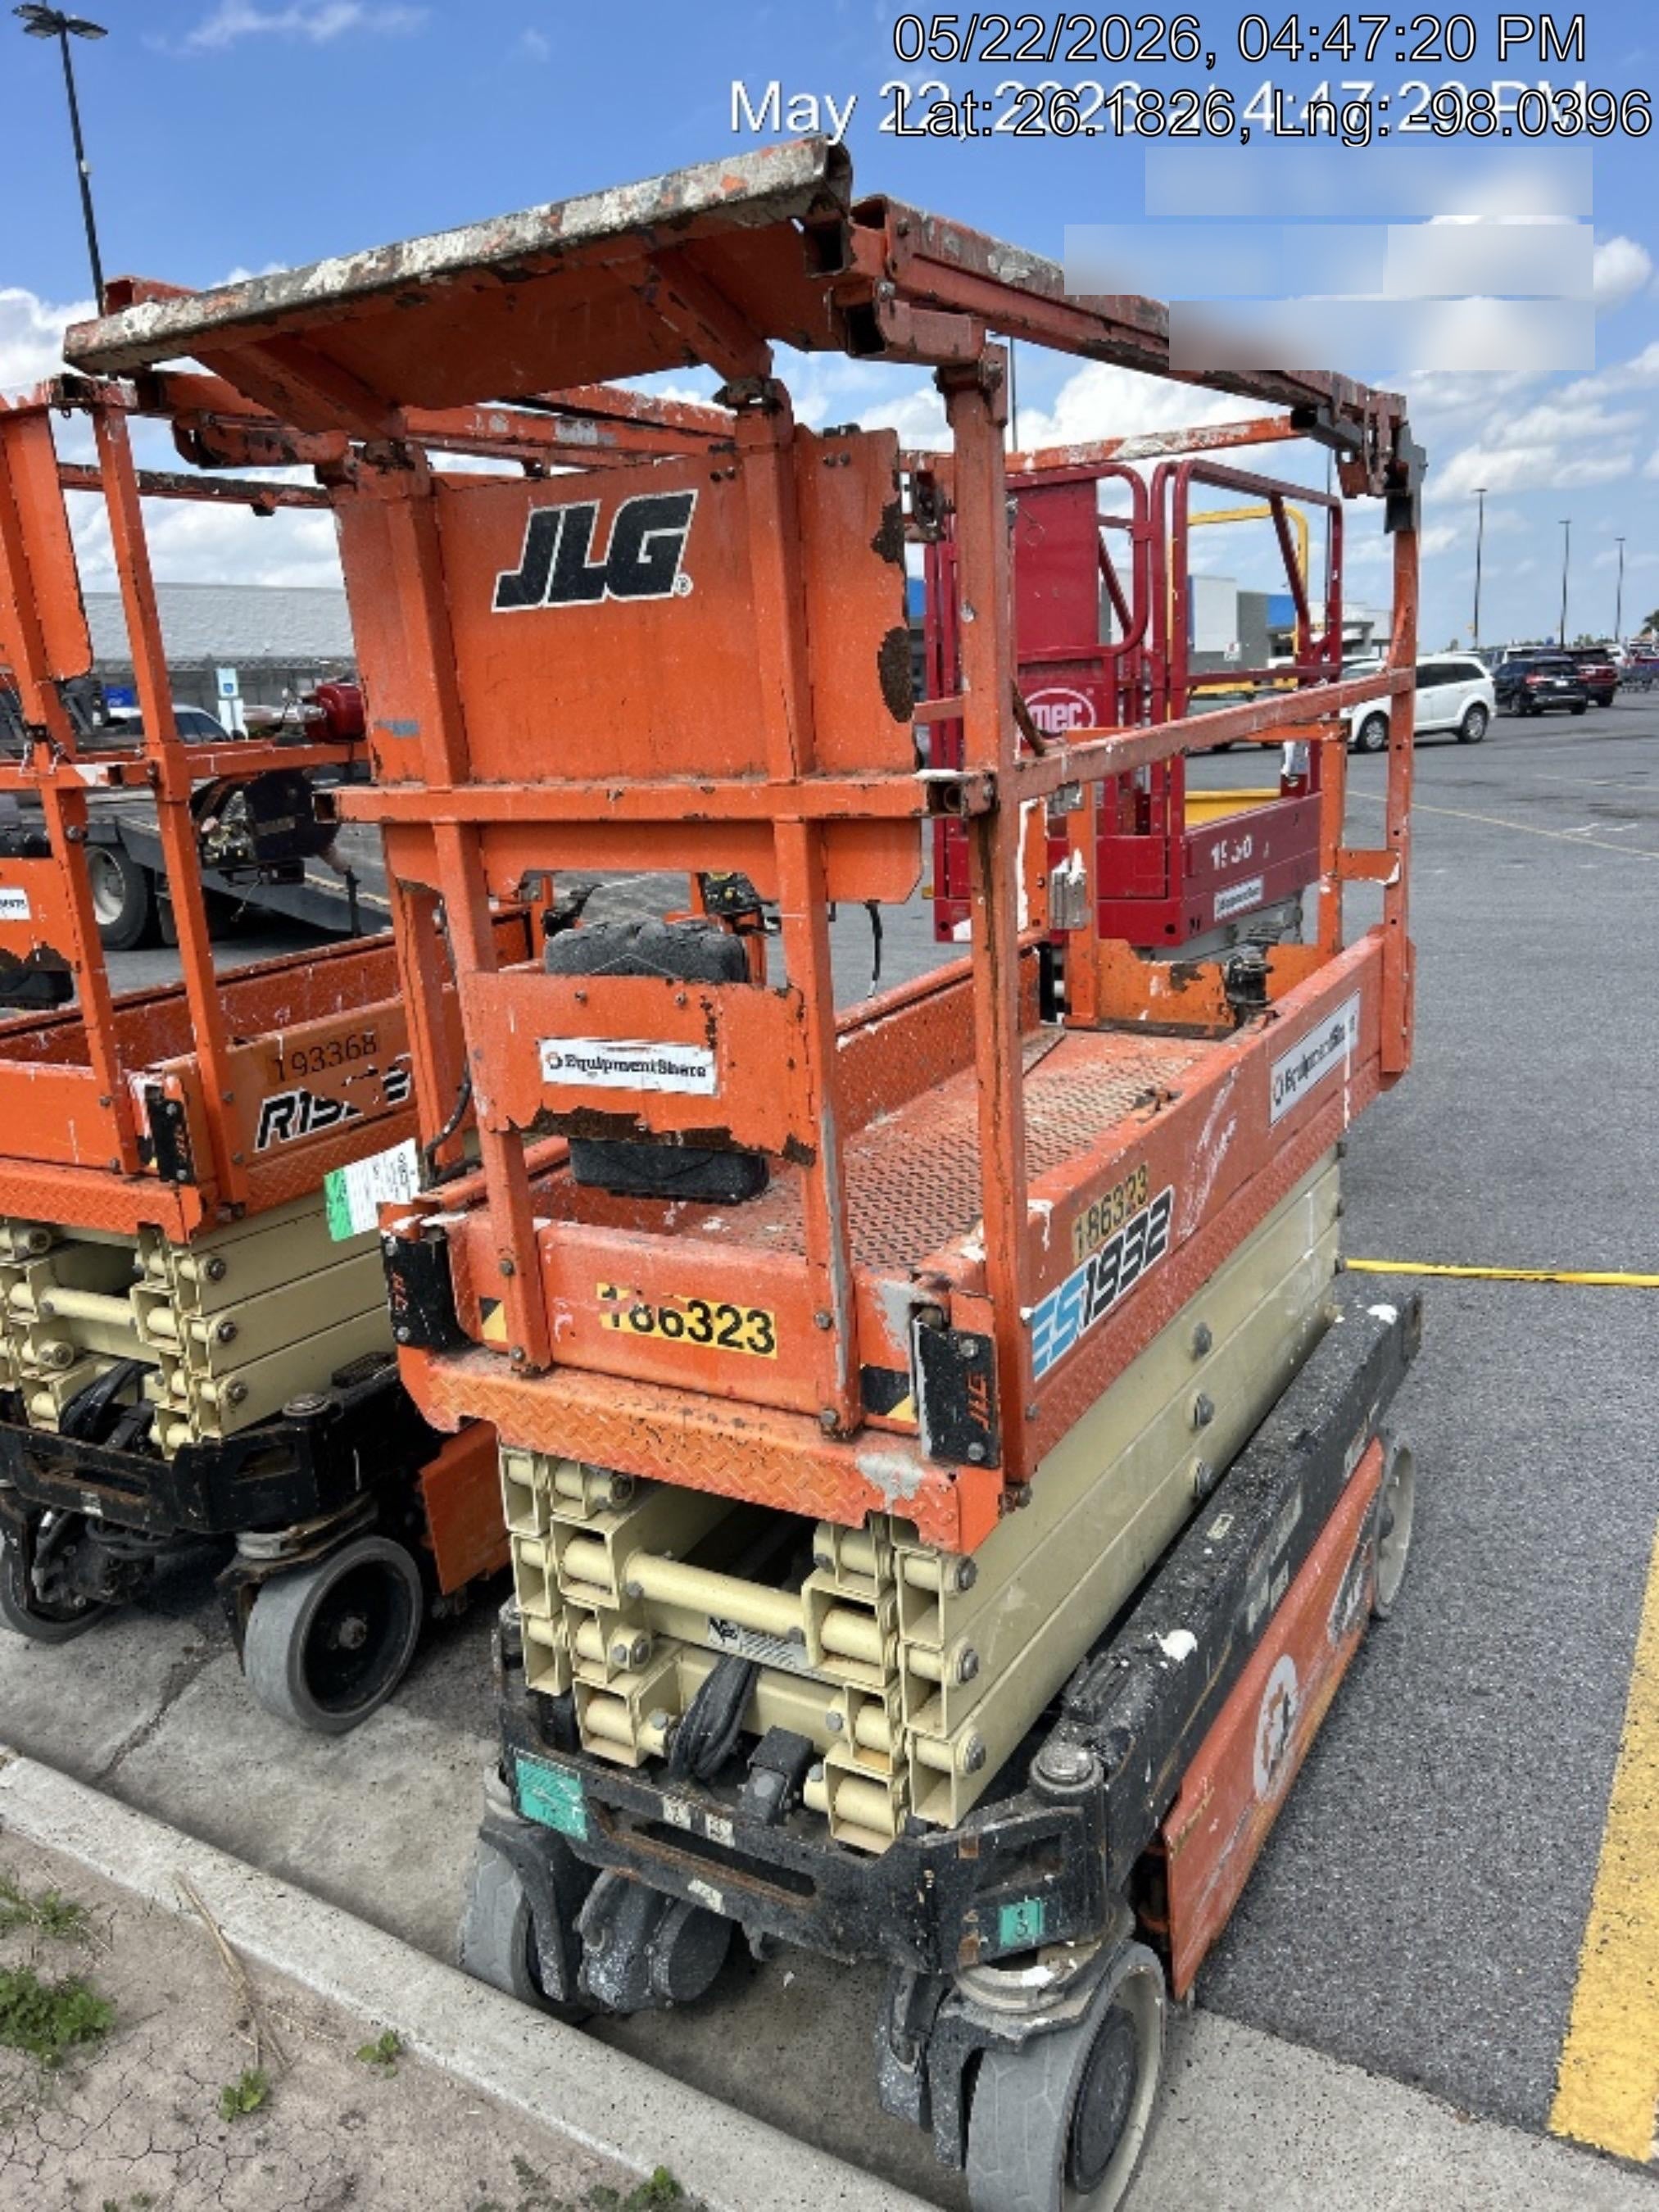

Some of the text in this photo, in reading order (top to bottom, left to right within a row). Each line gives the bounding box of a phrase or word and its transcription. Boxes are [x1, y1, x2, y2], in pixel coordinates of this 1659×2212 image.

[492, 489, 698, 613] JLG
[273, 1031, 377, 1081] 193368
[564, 1054, 706, 1077] EquipmentShare
[1031, 1185, 1174, 1380] ES1932
